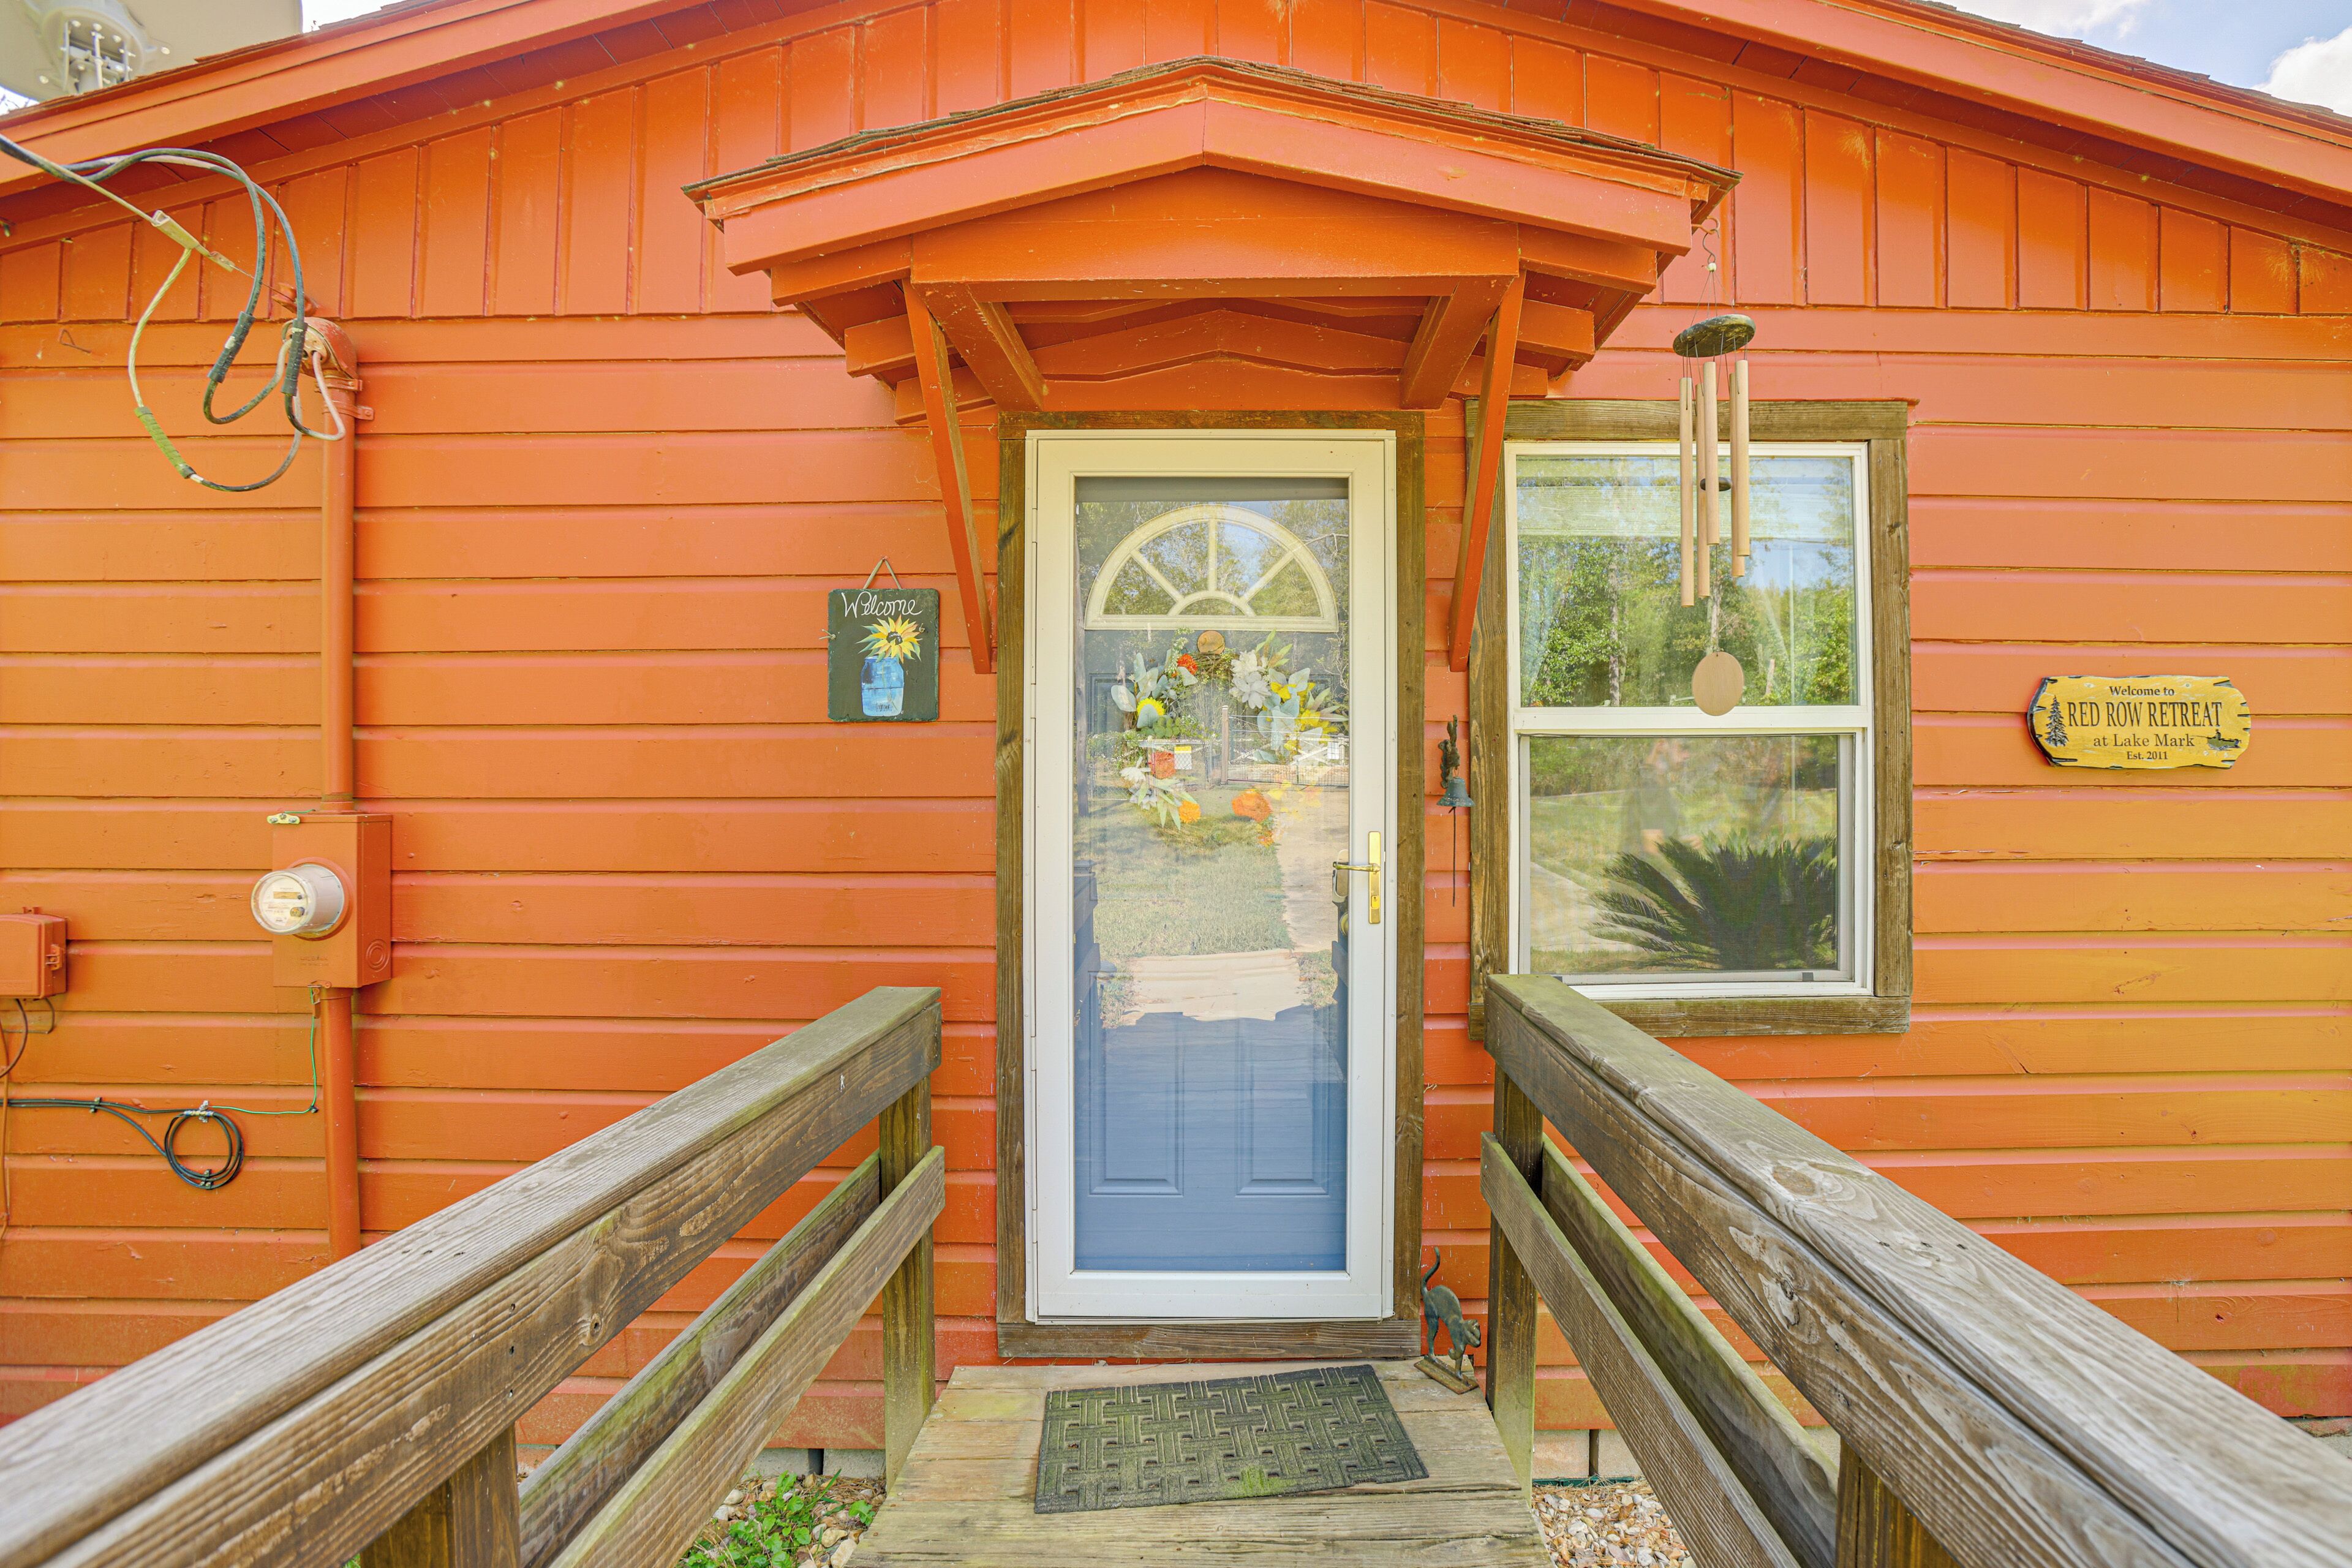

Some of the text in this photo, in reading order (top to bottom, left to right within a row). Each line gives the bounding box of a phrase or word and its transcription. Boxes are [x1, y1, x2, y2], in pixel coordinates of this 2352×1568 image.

[841, 591, 922, 618] Welcome
[2109, 686, 2175, 696] Welcome to
[2067, 701, 2222, 727] RED ROW RETREAT
[2094, 733, 2195, 747] at Lake Mark
[2127, 751, 2168, 760] Est. 2011
